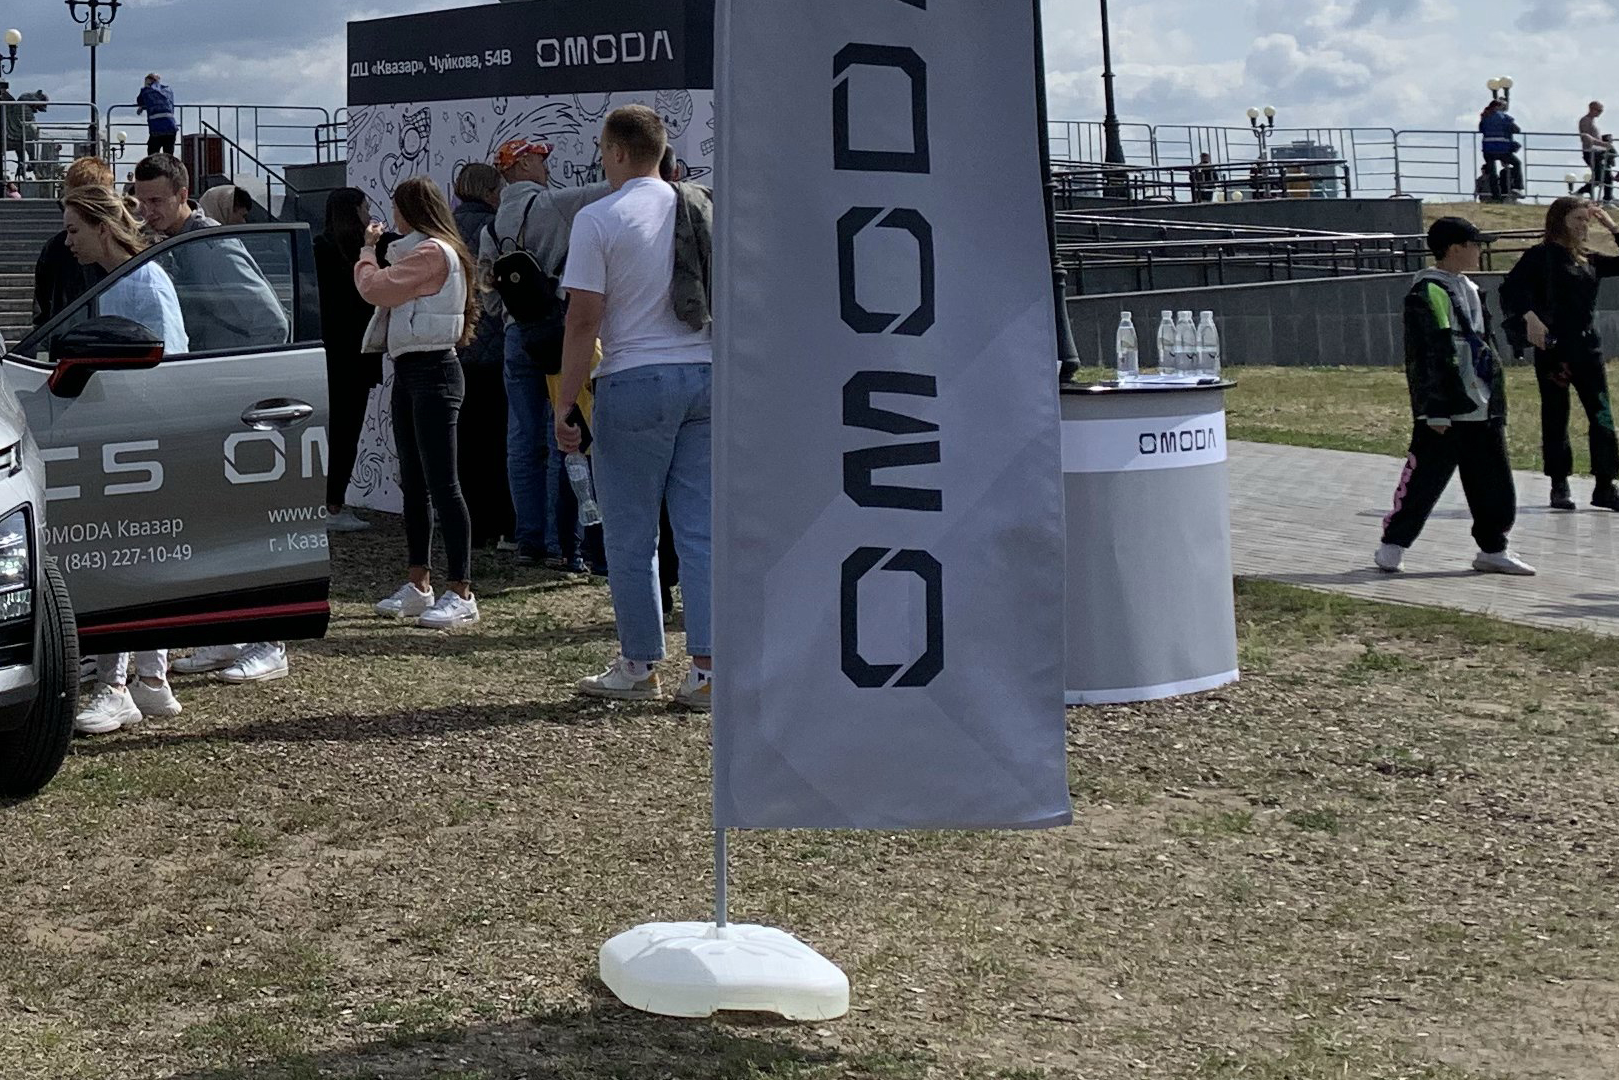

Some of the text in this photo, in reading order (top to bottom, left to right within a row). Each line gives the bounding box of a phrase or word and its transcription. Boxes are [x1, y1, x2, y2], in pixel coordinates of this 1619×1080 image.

[535, 29, 674, 68] OMODA
[350, 61, 370, 77] ДЦ
[429, 53, 482, 74] Чуйкова,
[1139, 427, 1217, 455] OMODA
[117, 517, 184, 539] Квазар
[65, 544, 193, 573] (843) 227-10-49
